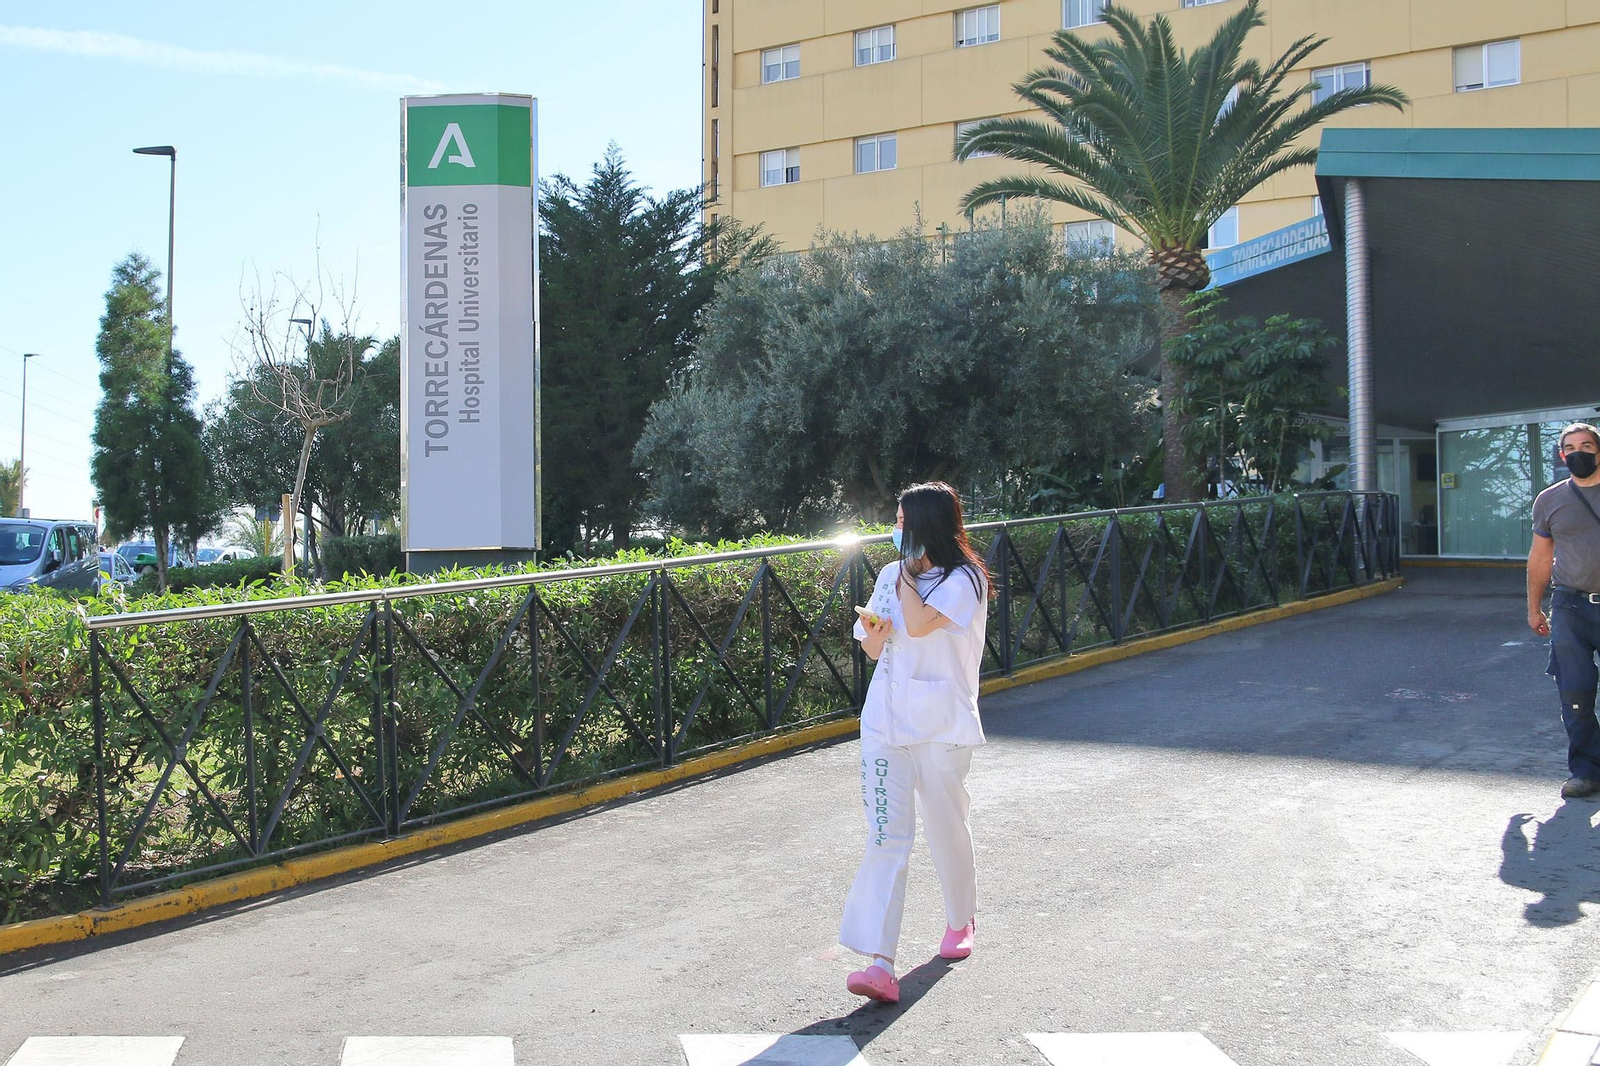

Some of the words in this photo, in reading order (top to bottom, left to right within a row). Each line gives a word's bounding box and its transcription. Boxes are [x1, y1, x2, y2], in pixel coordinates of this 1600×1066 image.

[419, 203, 449, 458] TORRECÁRDENAS
[457, 203, 480, 332] Universitario
[458, 341, 485, 423] Hospital
